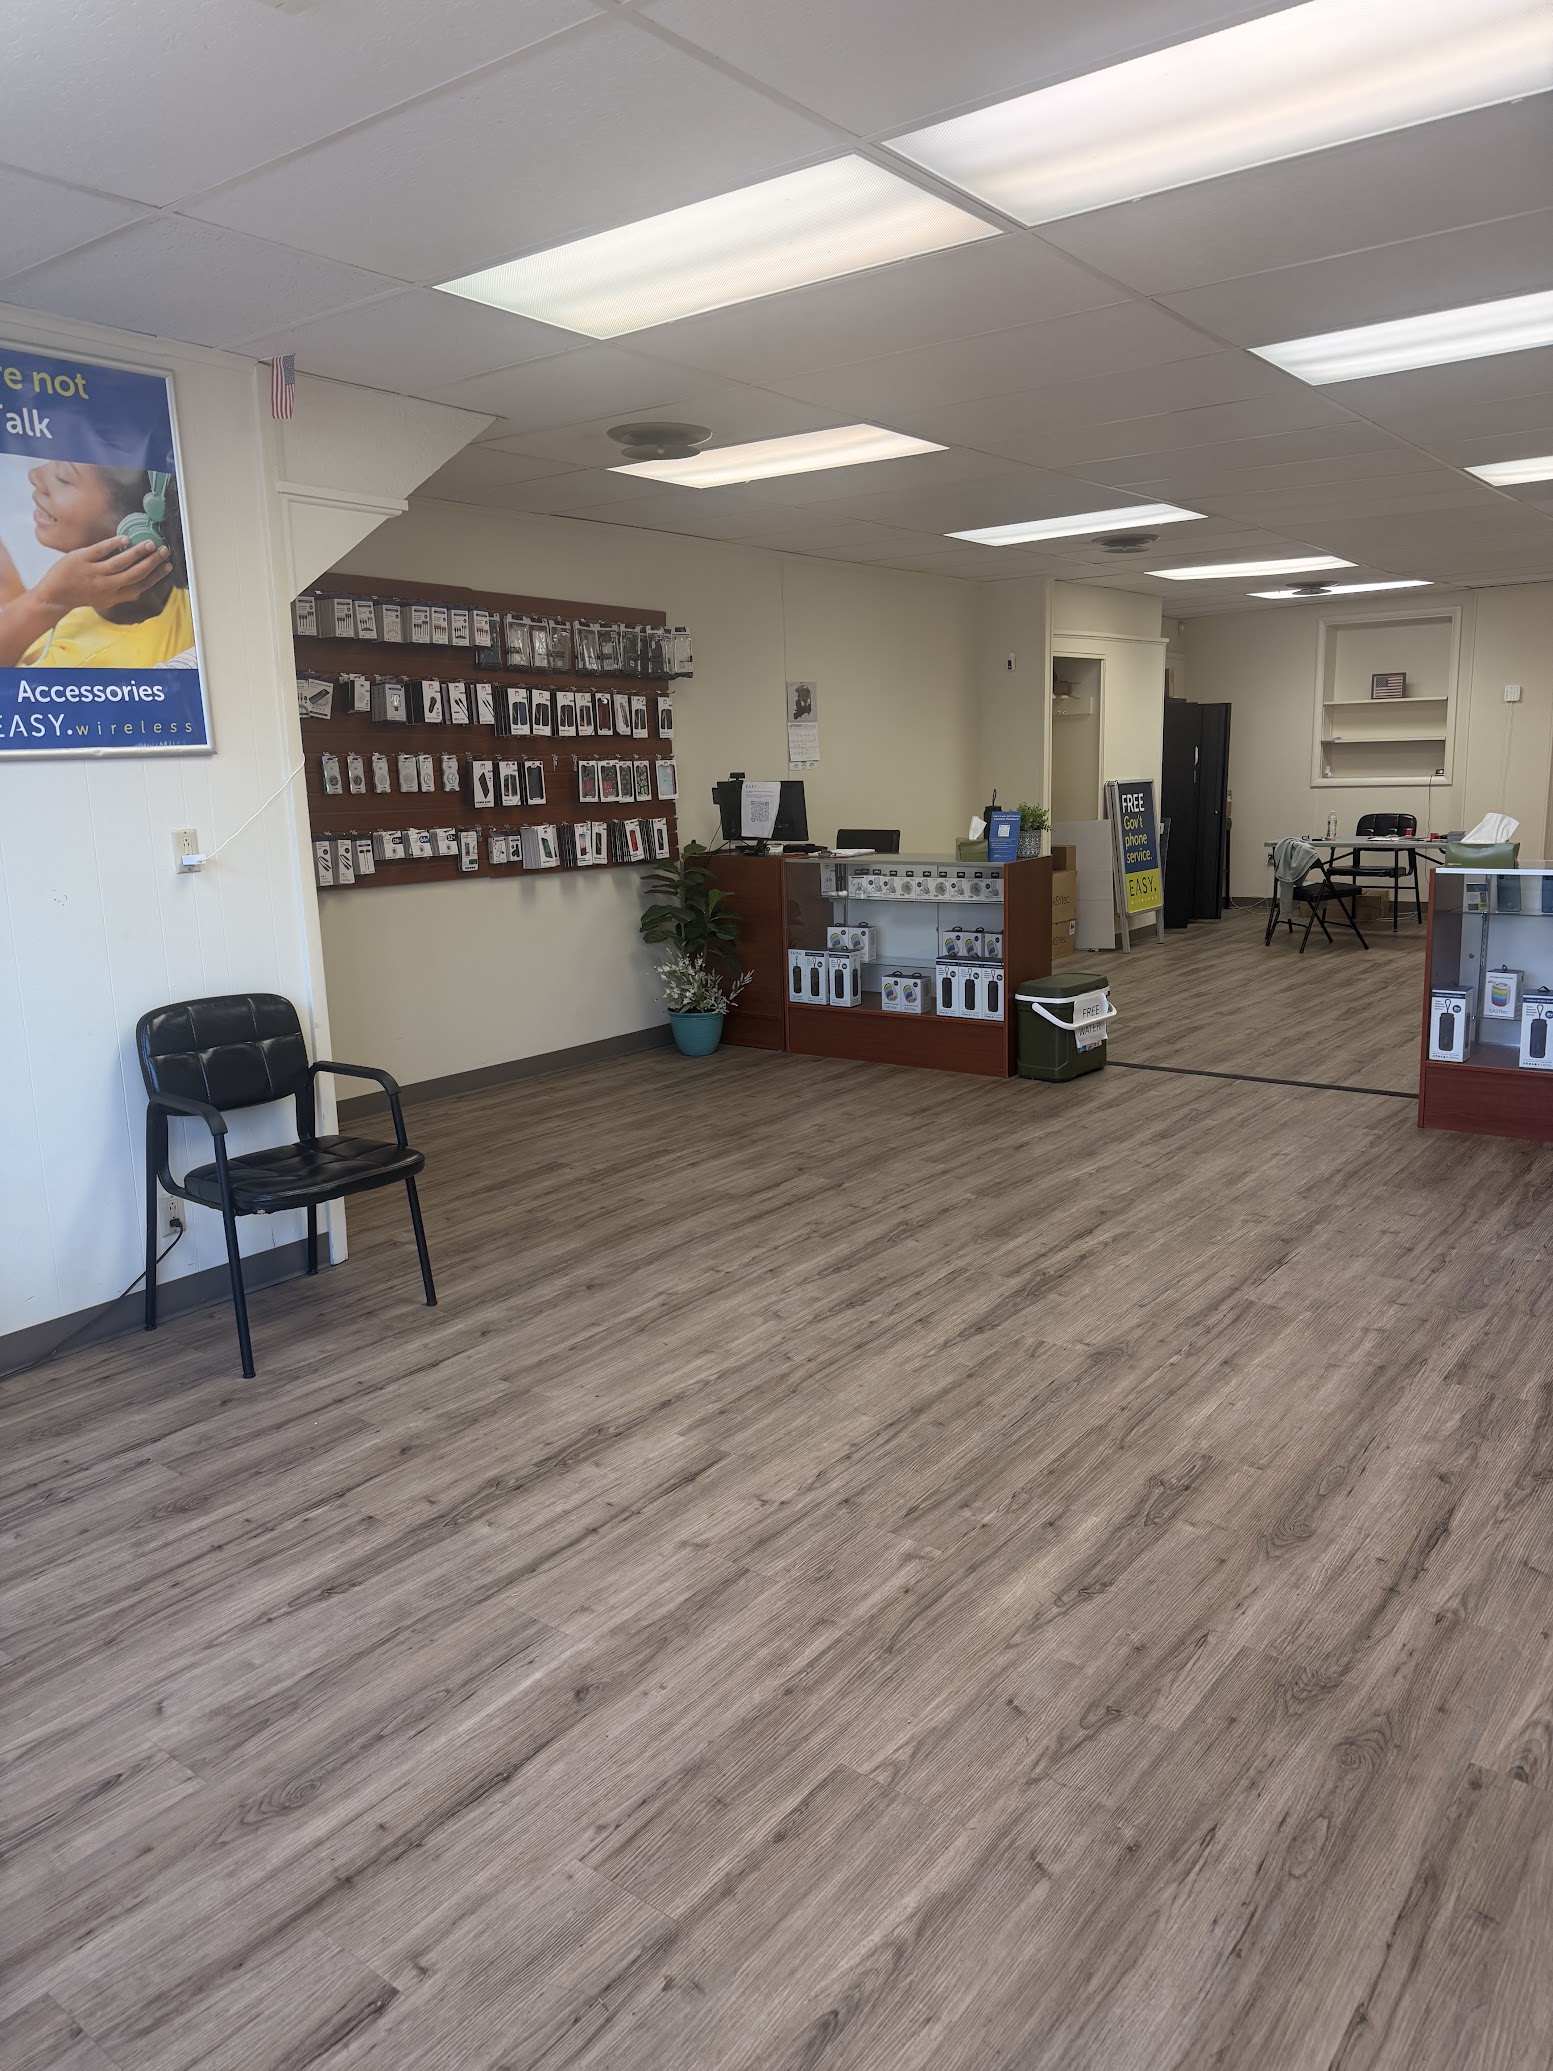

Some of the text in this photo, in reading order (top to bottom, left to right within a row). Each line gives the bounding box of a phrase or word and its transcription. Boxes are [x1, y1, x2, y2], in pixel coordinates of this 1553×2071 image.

[0, 366, 89, 399] e not
[0, 403, 53, 439] alk
[17, 680, 165, 703] Accessories
[1121, 793, 1145, 814] FREE
[1124, 814, 1144, 831] Gov't
[1125, 832, 1148, 850] phone
[1126, 847, 1153, 864] service.
[1082, 1004, 1101, 1019] FREE
[1078, 1022, 1102, 1037] WATER
